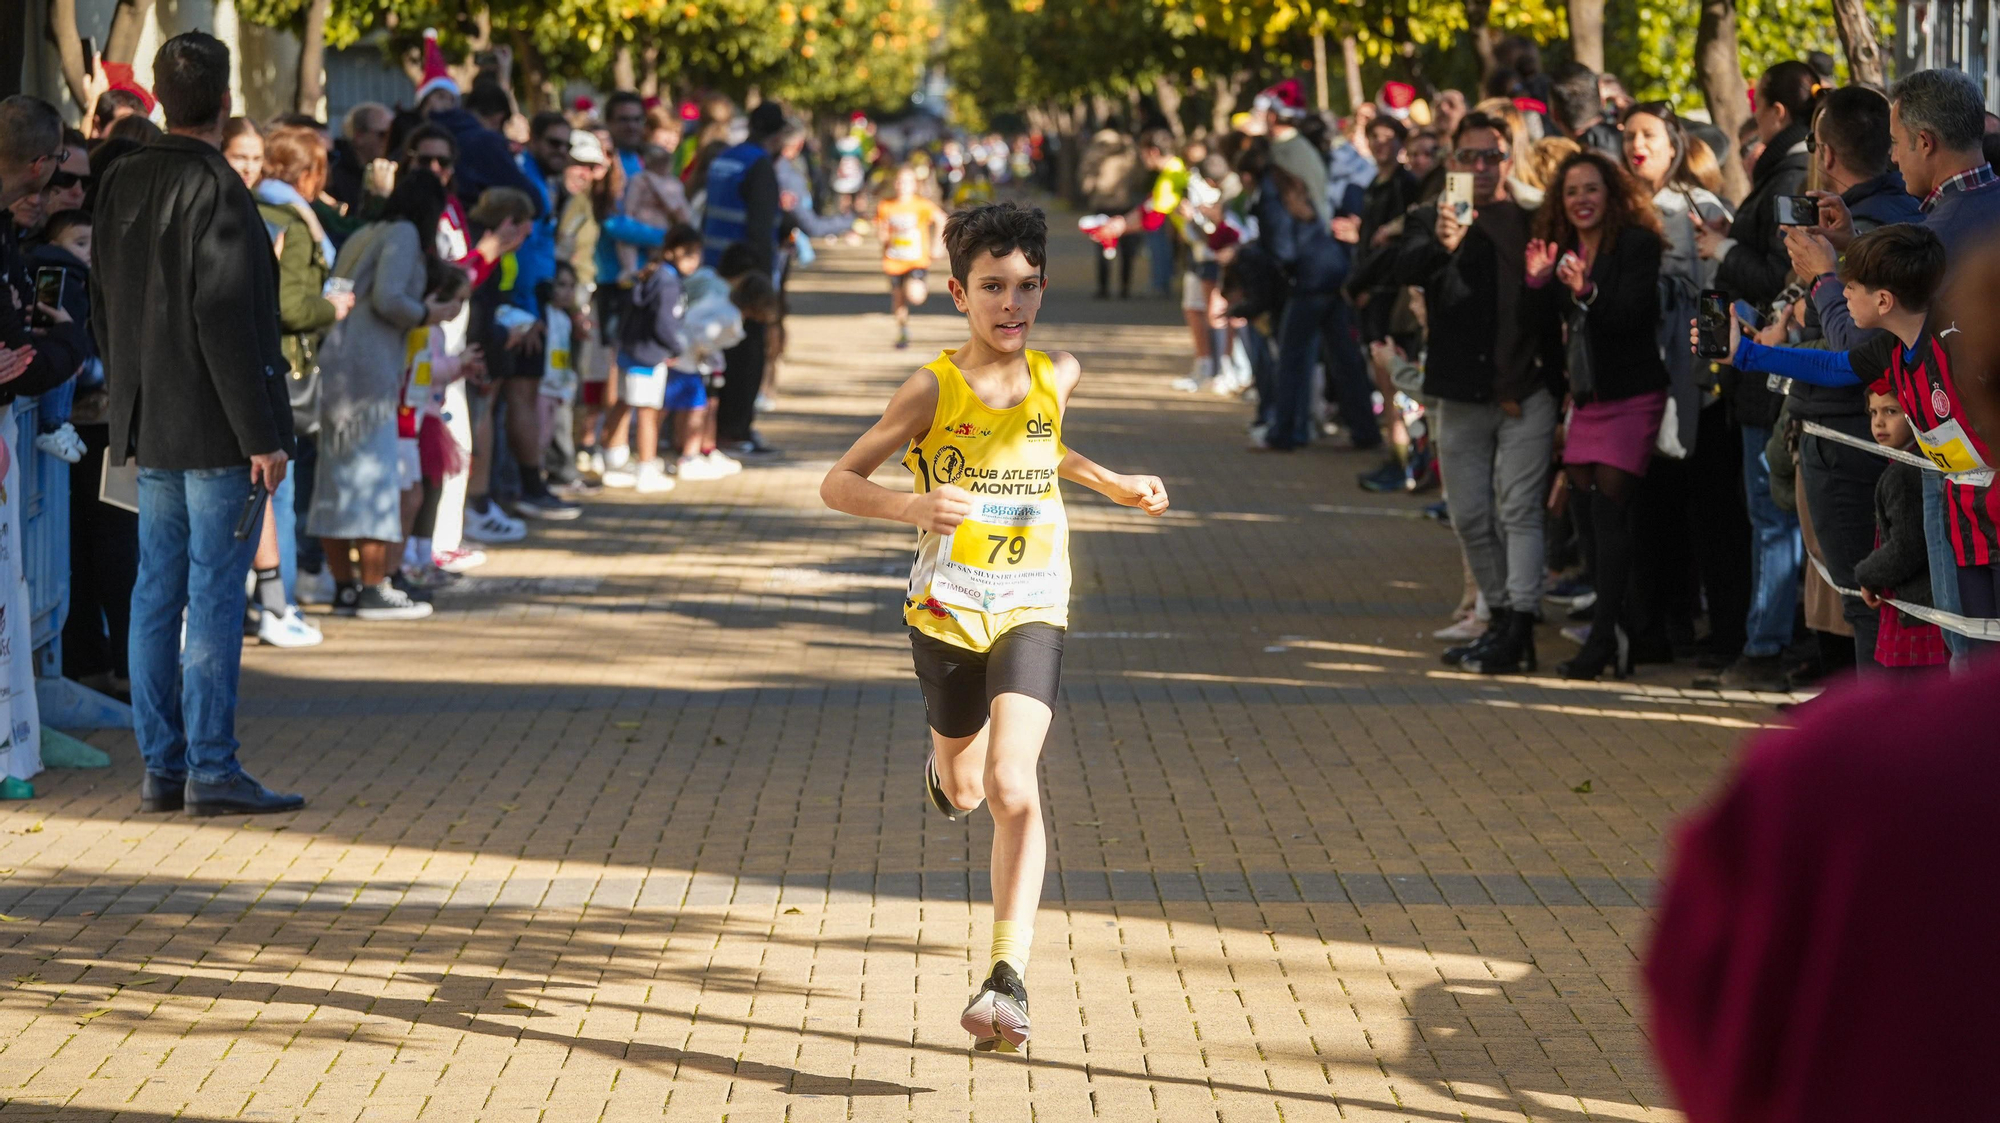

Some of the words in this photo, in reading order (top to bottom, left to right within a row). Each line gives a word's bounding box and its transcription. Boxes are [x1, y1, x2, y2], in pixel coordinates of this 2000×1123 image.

[1929, 450, 1952, 468] 67
[964, 467, 998, 480] CLUB
[970, 482, 1051, 495] MONTILLA
[988, 534, 1026, 564] 79
[958, 565, 972, 574] SAN
[947, 584, 981, 598] IMDECO
